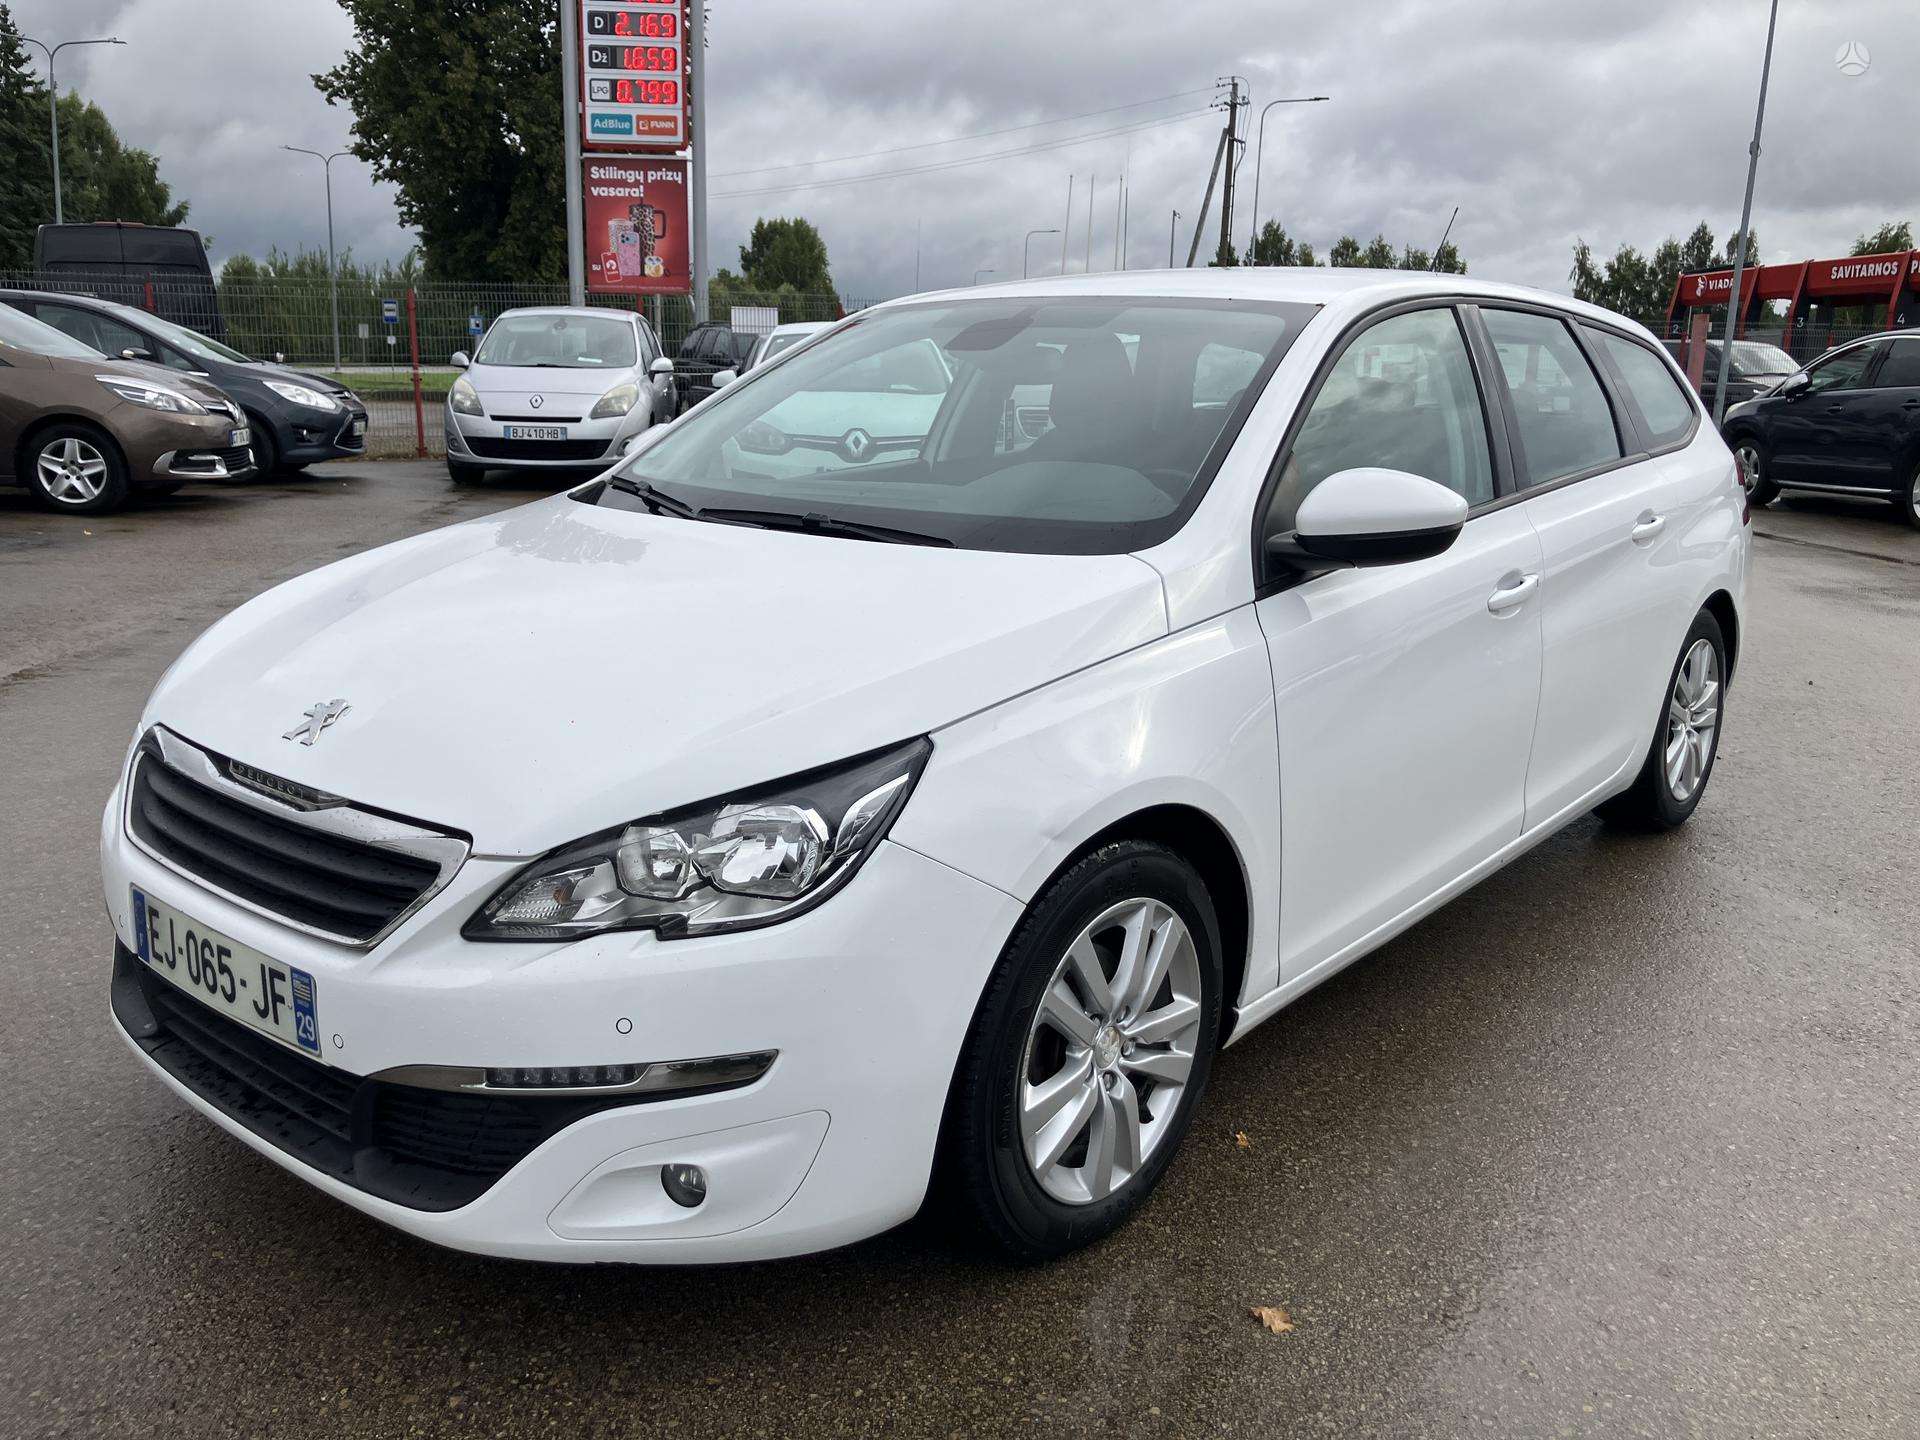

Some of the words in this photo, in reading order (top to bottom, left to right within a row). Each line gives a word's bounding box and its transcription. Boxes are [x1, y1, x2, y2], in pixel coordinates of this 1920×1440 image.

[594, 16, 604, 29] D
[615, 11, 675, 38] 2.169
[591, 50, 608, 63] Dž
[592, 86, 609, 95] LPG
[593, 118, 631, 129] AdBlue
[590, 184, 644, 197] vasara!
[1831, 261, 1899, 280] SAVITARNOS
[1796, 316, 1804, 328] 3
[1896, 312, 1905, 325] 4
[296, 1010, 315, 1042] 29
